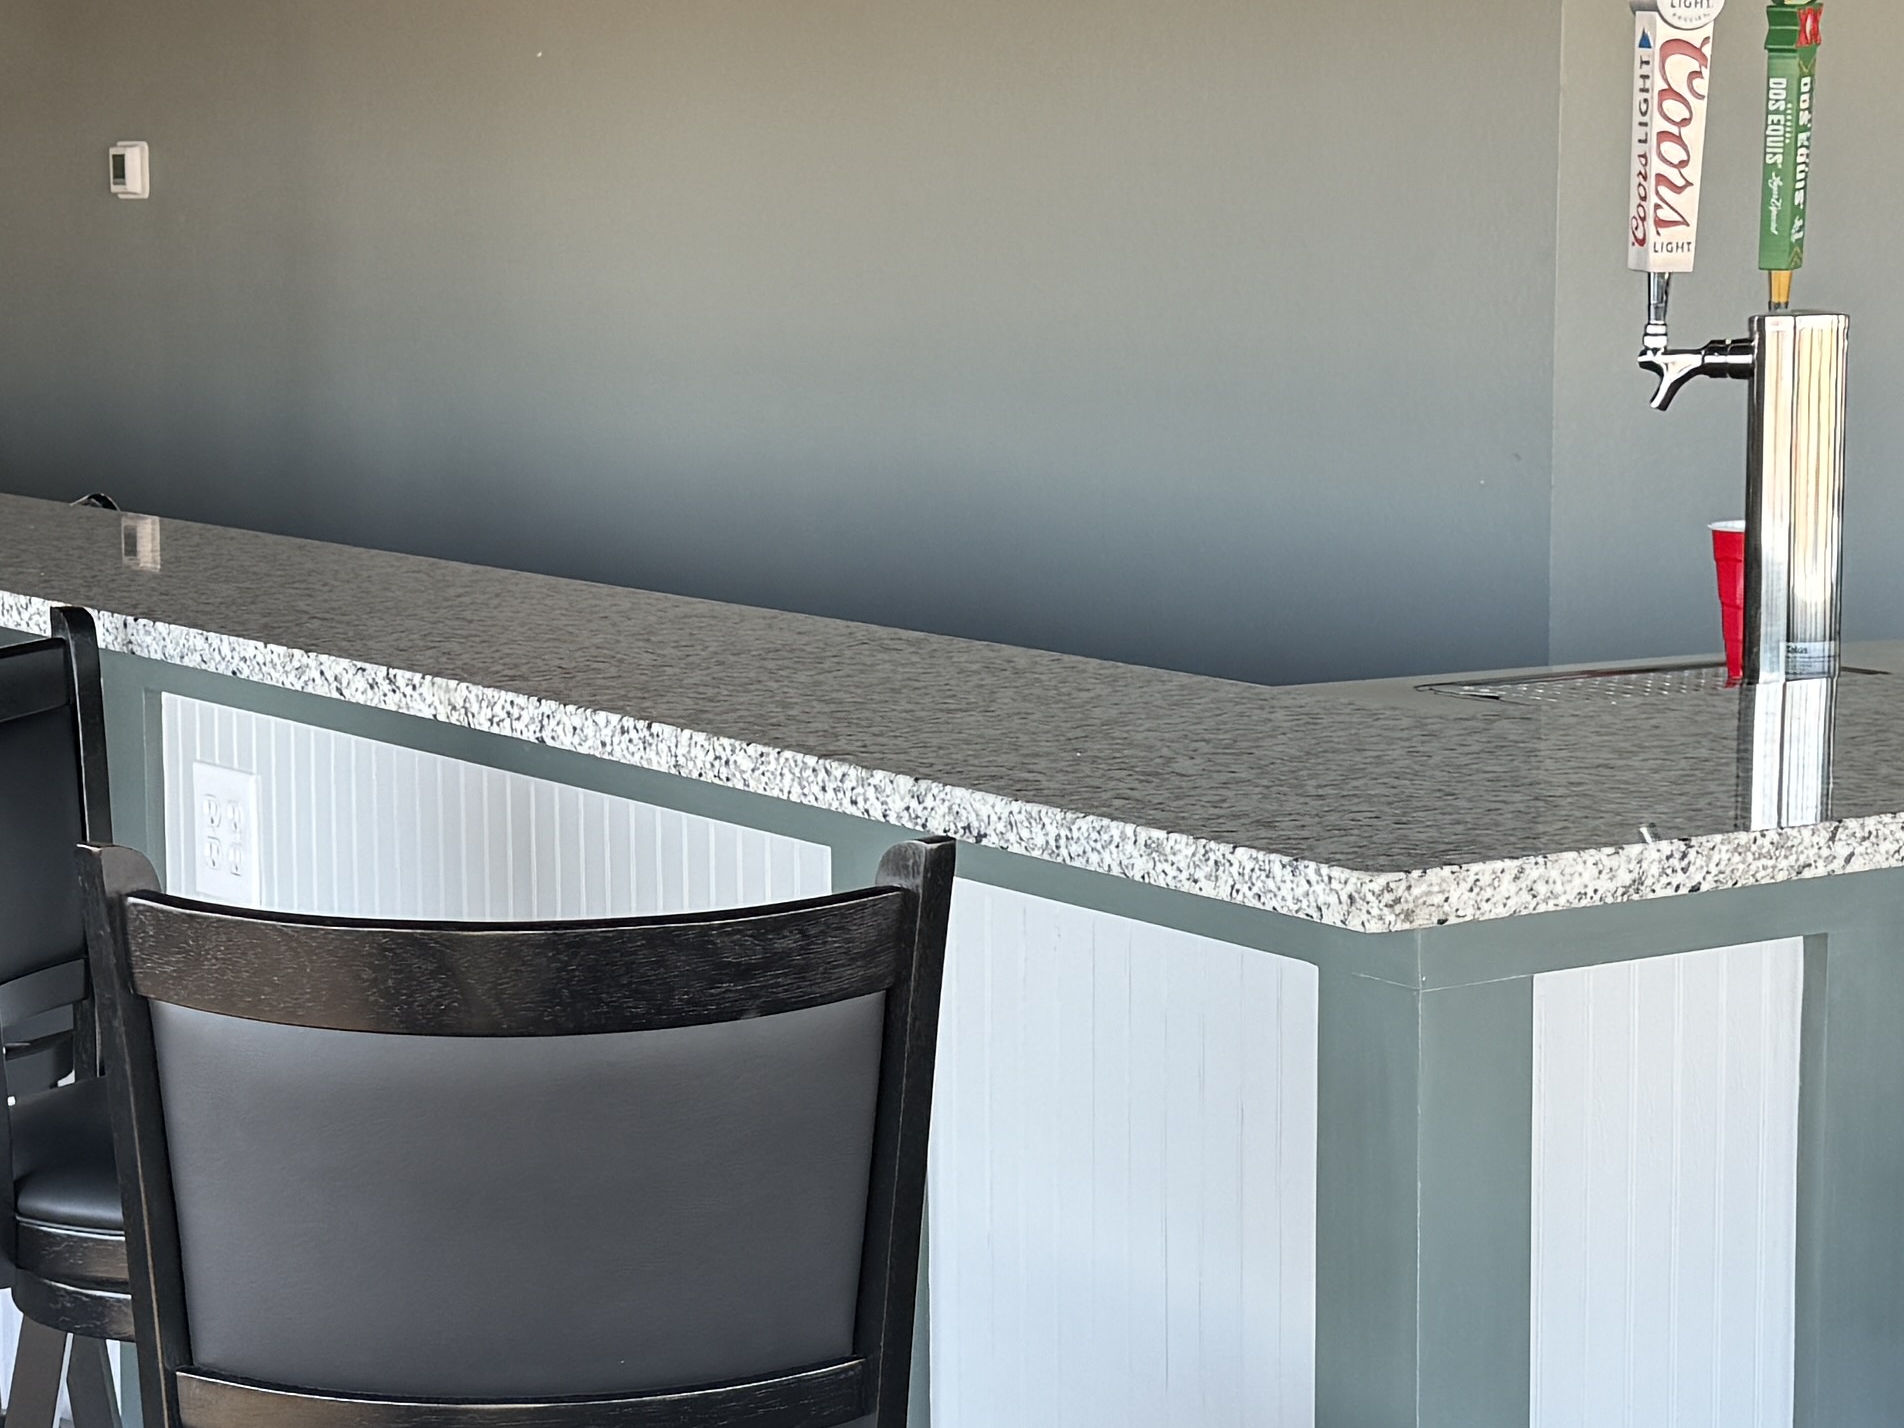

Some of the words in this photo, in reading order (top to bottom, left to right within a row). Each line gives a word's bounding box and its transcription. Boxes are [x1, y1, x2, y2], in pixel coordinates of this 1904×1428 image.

[1637, 56, 1651, 145] LIGHT
[1768, 77, 1787, 112] DOS
[1799, 76, 1812, 127] DOS
[1654, 36, 1711, 237] Coors
[1765, 114, 1785, 166] EQUIS
[1631, 154, 1649, 247] Coors
[1653, 241, 1692, 253] LIGHT
